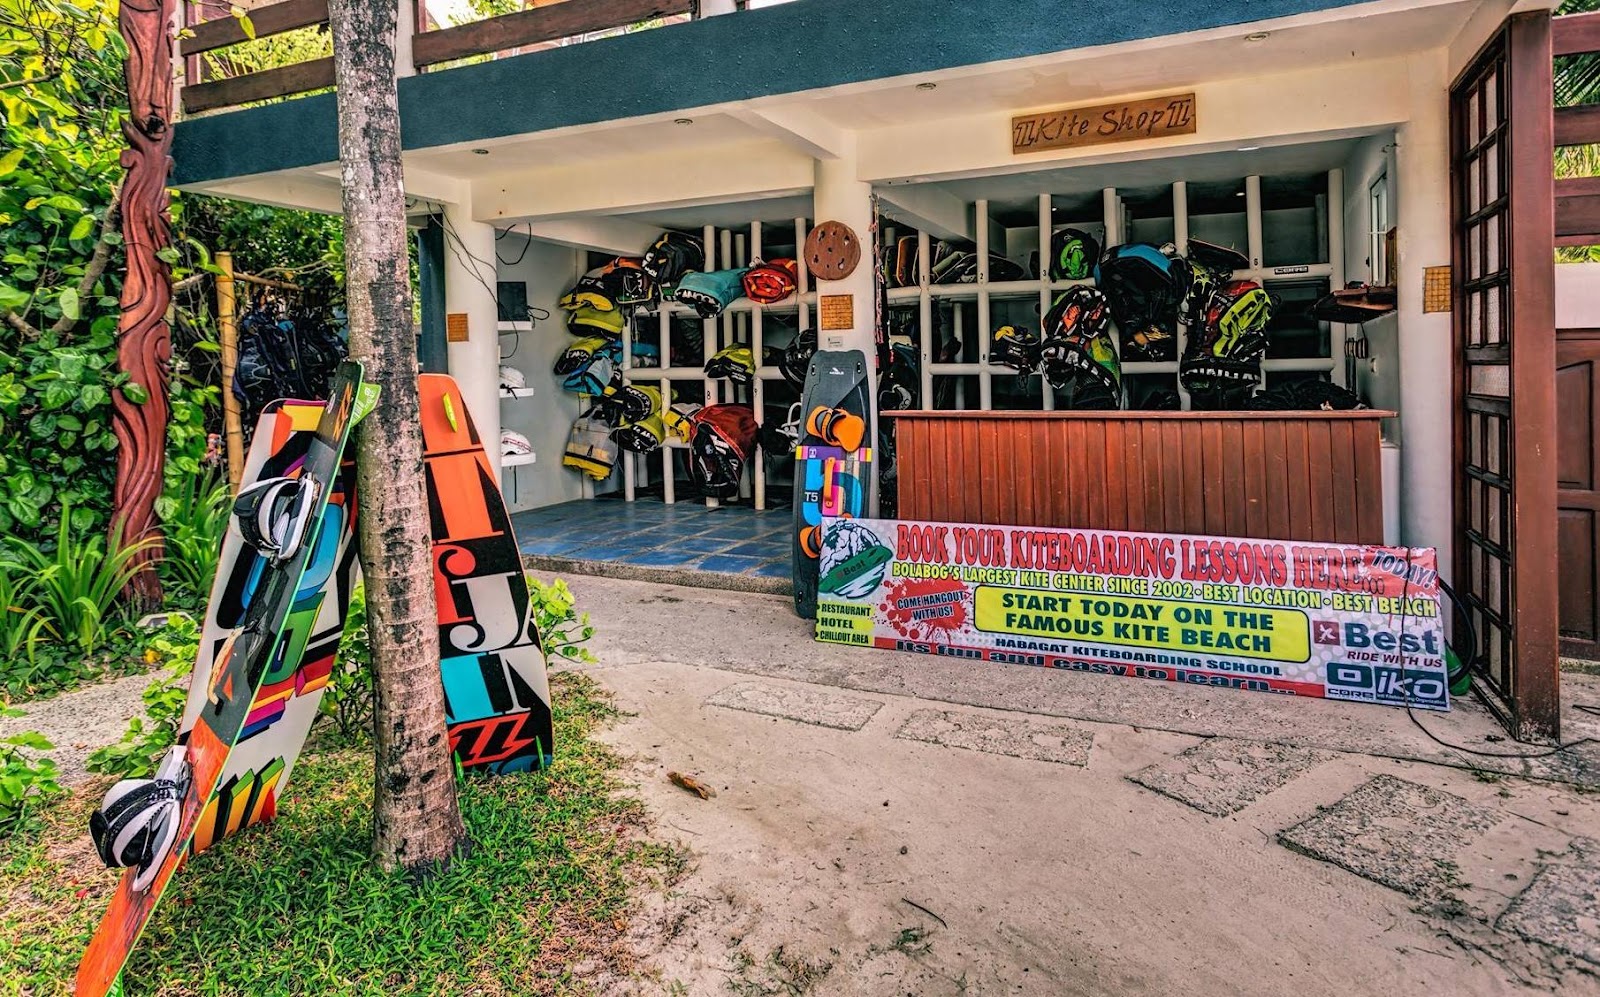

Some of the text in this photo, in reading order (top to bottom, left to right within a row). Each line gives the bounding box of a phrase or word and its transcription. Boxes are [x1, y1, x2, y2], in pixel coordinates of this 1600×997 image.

[1034, 107, 1165, 143] Kite Shop
[804, 491, 819, 502] T5
[896, 524, 949, 565] BOOK
[953, 527, 1006, 568] YOUR
[1010, 530, 1177, 579] KITEBOARDING
[1180, 539, 1287, 587] LESSONS
[1371, 549, 1438, 589] TODAY!
[892, 562, 961, 581] BOLABOG'S
[963, 567, 1017, 586] LARGEST
[1020, 569, 1050, 589] KITE
[1053, 572, 1105, 592] CENTER
[1107, 577, 1149, 596] SINCE
[1243, 586, 1322, 609] LOCATION
[1332, 592, 1373, 614] BEST
[1378, 596, 1437, 618] BEACH
[897, 591, 964, 609] COME HANGOUT
[820, 617, 854, 630] HOTEL
[821, 603, 871, 617] RESTAURANT
[912, 606, 954, 621] WITH US!
[1002, 593, 1274, 631] START TODAY ON THE
[820, 630, 869, 644] CHILLOUT AREA
[1006, 613, 1272, 653] FAMOUS KITE BEACH
[1344, 622, 1439, 655] Best
[937, 643, 983, 660] fun
[989, 651, 1045, 667] and
[1053, 658, 1128, 676] easy
[1134, 666, 1168, 681] to
[995, 638, 1283, 677] HABAGAT KITEBOARDING SCHOOL
[1347, 651, 1379, 662] RIDE
[1423, 658, 1443, 668] US
